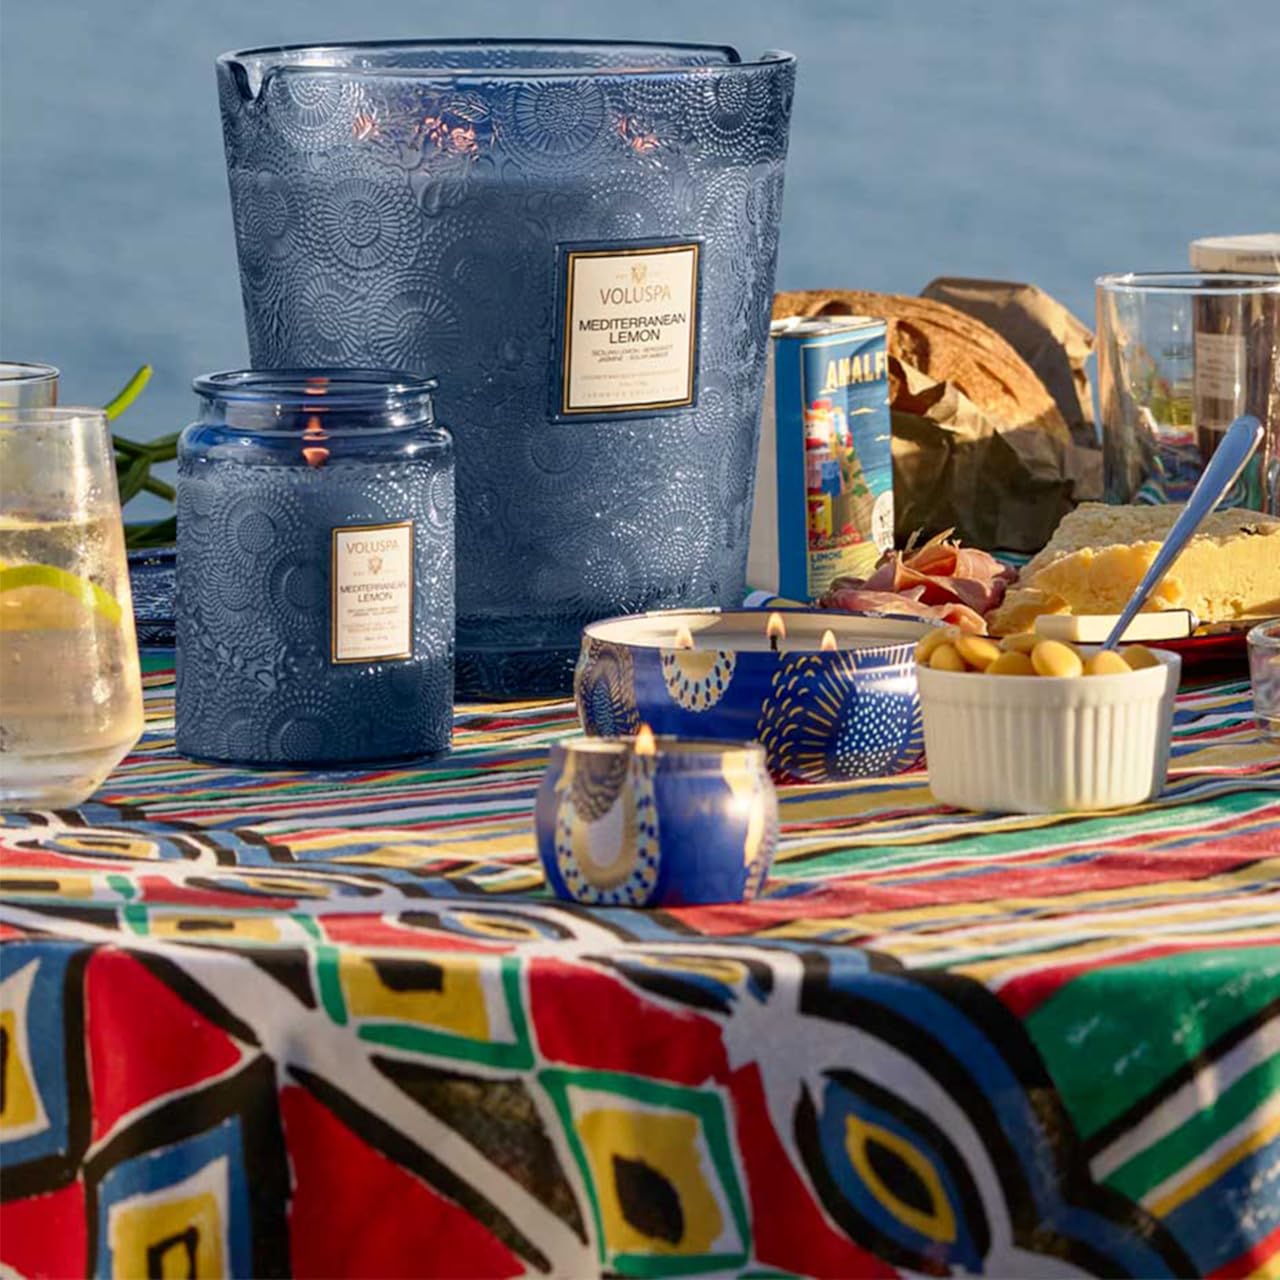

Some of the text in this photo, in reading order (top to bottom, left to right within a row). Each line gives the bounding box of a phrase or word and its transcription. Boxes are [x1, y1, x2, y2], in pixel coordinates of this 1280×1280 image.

[600, 284, 671, 305] VOLUSPA
[579, 312, 686, 332] MEDITERRANEAN
[609, 328, 660, 344] LEMON
[345, 539, 400, 554] VOLUSPA
[358, 591, 393, 603] LEMON
